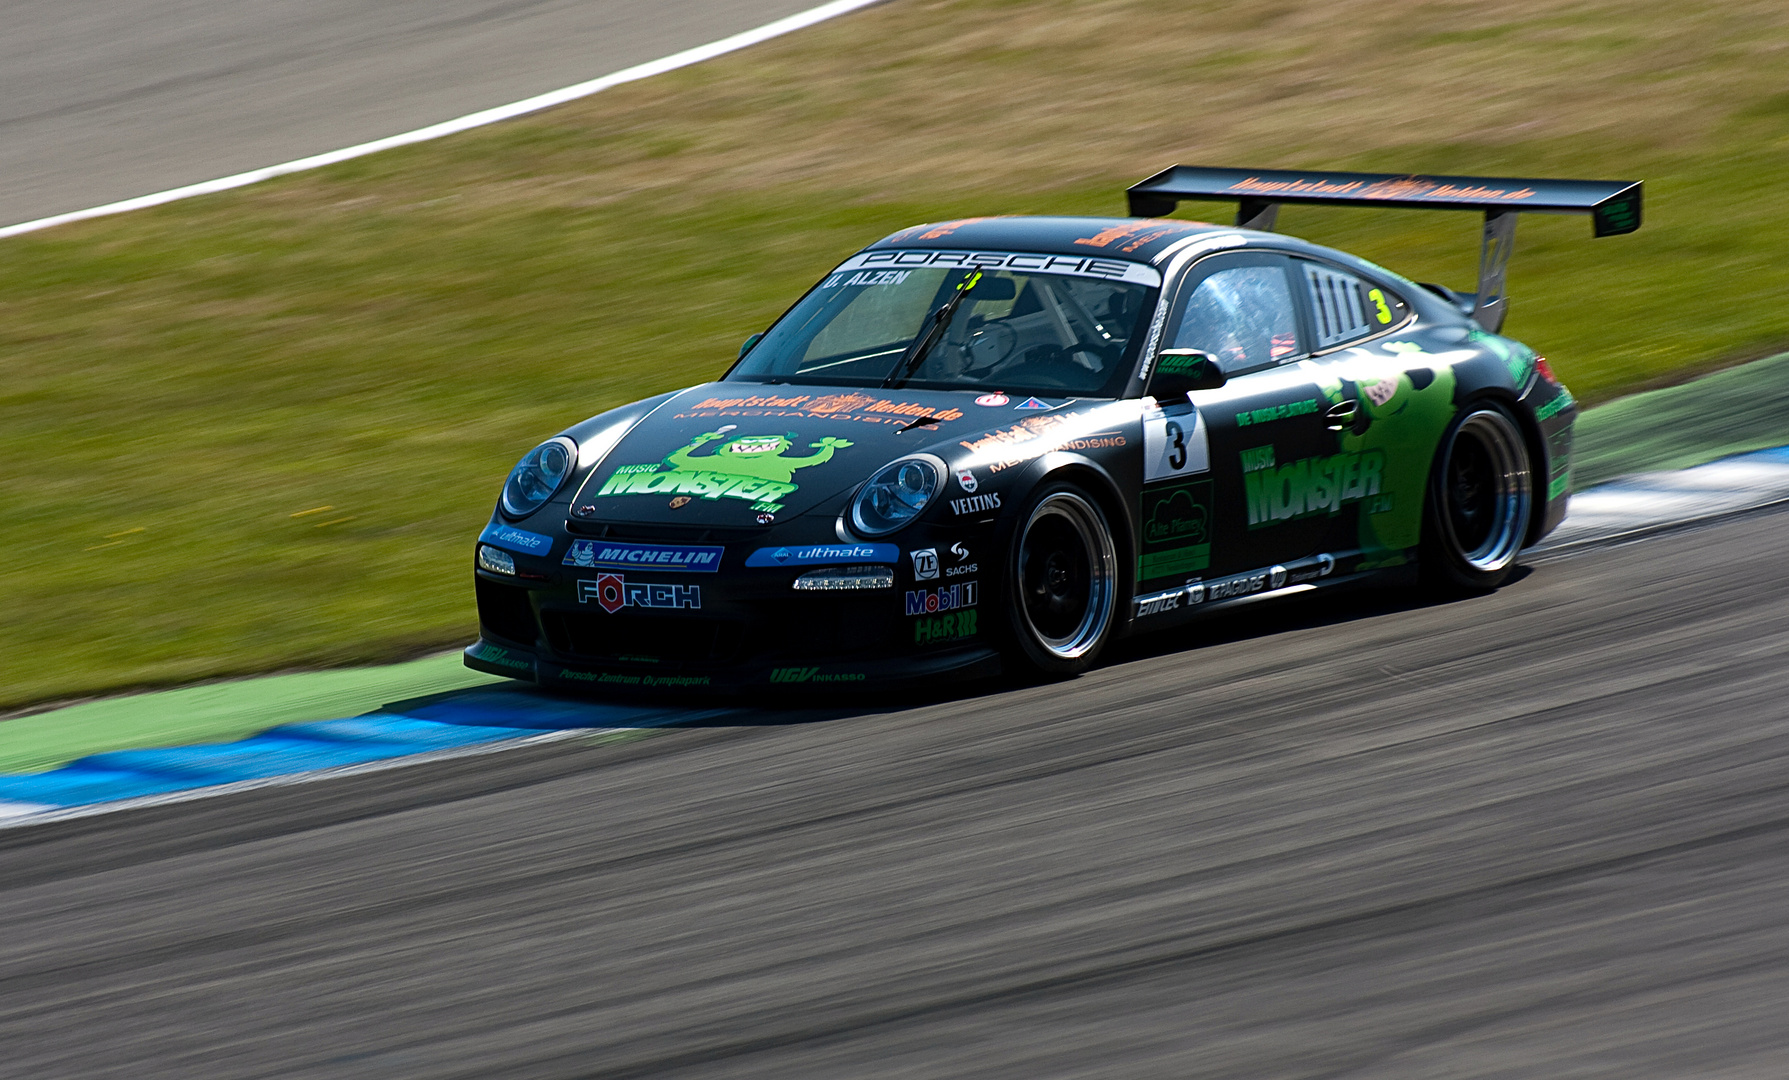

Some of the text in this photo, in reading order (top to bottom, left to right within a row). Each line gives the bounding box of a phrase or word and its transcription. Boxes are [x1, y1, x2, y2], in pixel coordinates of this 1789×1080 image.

[860, 252, 1130, 279] PORSCHE
[822, 270, 912, 290] U. ALZEN
[1368, 288, 1393, 325] 3
[691, 395, 811, 411] Hauptstadt
[864, 400, 964, 421] Helden.de
[1165, 420, 1188, 471] 3
[615, 463, 661, 475] MUSIC
[1241, 444, 1276, 474] MUSIC
[598, 470, 798, 504] MONSTER
[1244, 449, 1386, 528] MONSTER
[949, 492, 1002, 516] VELTINS
[499, 531, 542, 549] ultimate
[798, 546, 874, 559] ultimate
[597, 546, 718, 565] MICHELIN
[916, 554, 940, 575] ZF
[945, 563, 979, 578] SACHS
[905, 583, 961, 616] Mobil
[913, 615, 958, 646] H&R
[769, 666, 867, 684] UGV INKASSO
